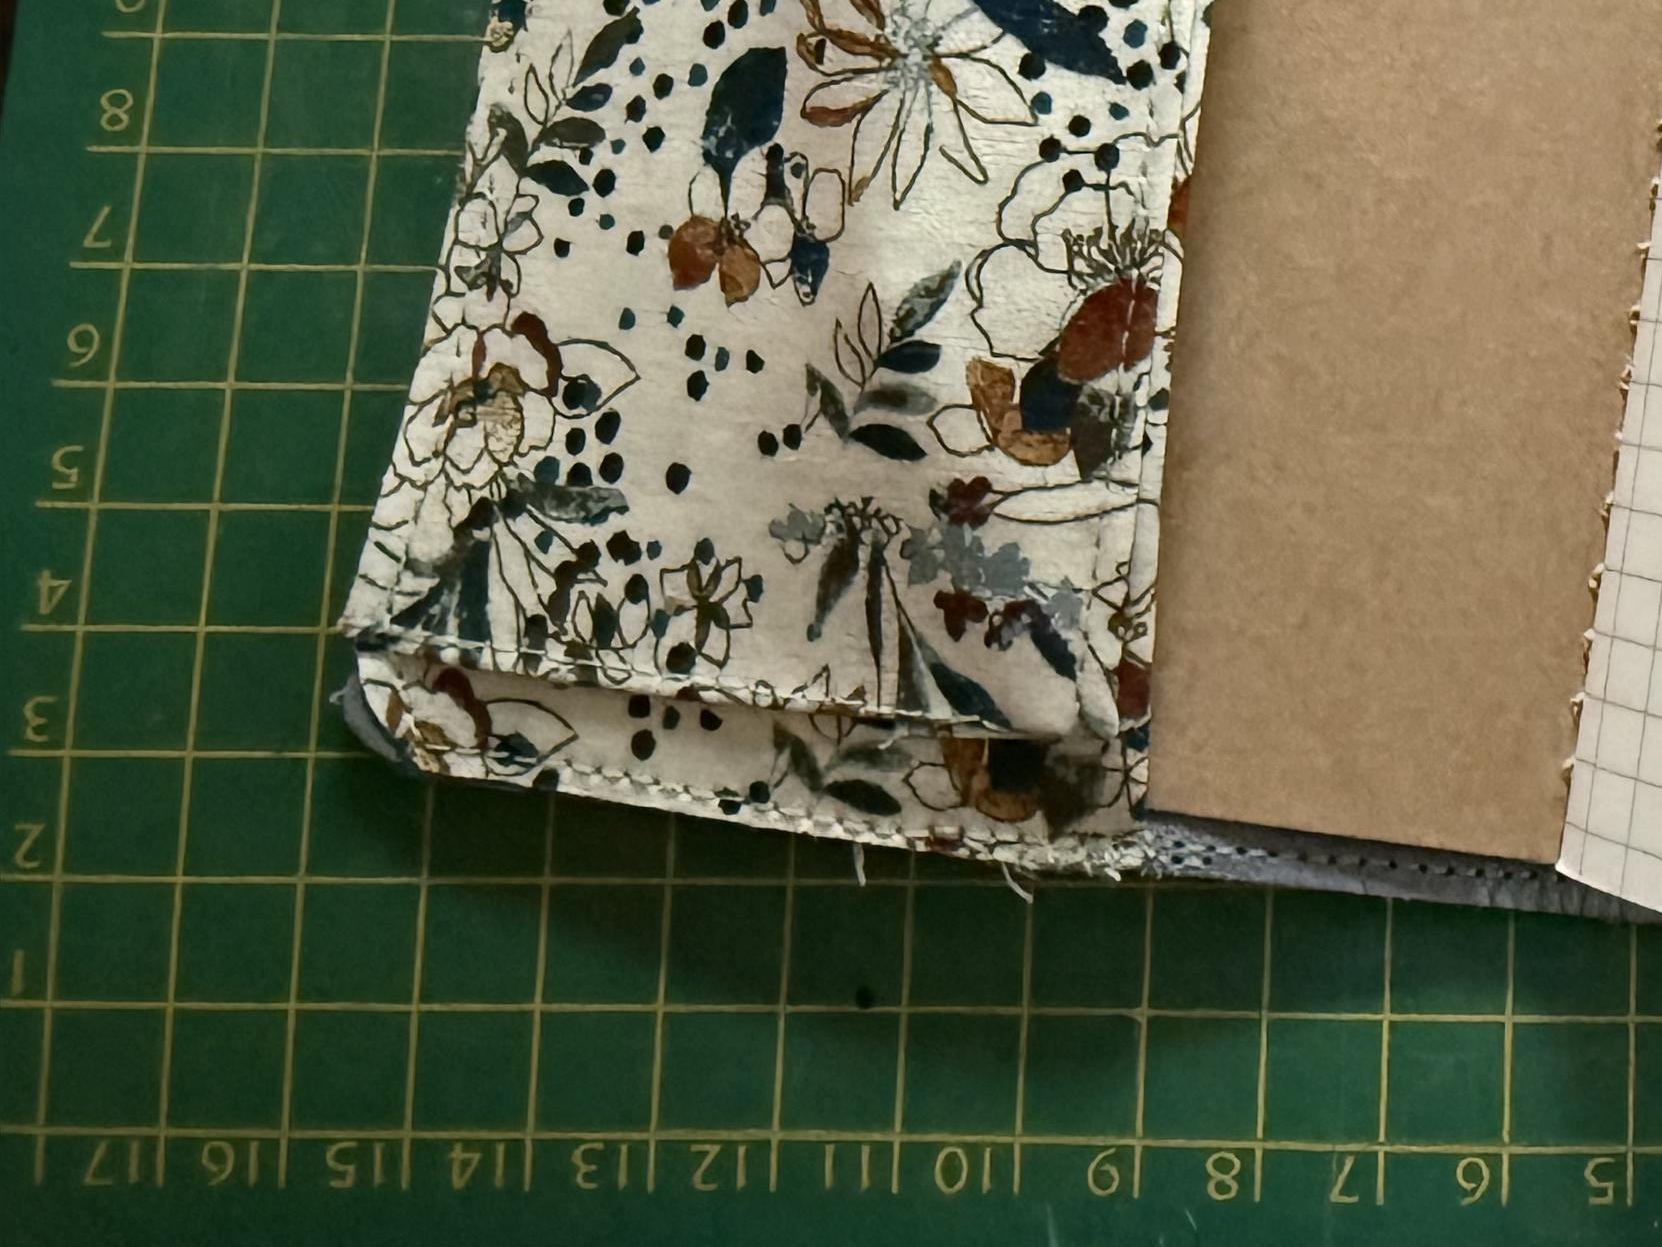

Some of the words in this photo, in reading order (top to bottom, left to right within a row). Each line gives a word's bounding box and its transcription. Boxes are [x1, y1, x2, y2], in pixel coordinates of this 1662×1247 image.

[100, 88, 133, 131] 8
[83, 205, 111, 248] 7
[67, 323, 100, 367] 6
[51, 445, 84, 489] 5
[37, 569, 72, 615] 4
[23, 695, 58, 743] 3
[14, 823, 46, 869] 2
[83, 1139, 140, 1186] 17
[201, 1140, 259, 1187] 16
[325, 1141, 386, 1189] 15
[447, 1142, 507, 1190] 14
[571, 1142, 628, 1190] 13
[690, 1143, 746, 1192] 12
[825, 1143, 871, 1191] 11
[934, 1146, 992, 1195] 10
[1087, 1148, 1120, 1197] 9
[1205, 1151, 1241, 1201] 8
[1329, 1156, 1359, 1203] 7
[1455, 1157, 1490, 1206] 6
[1584, 1157, 1615, 1205] 5
